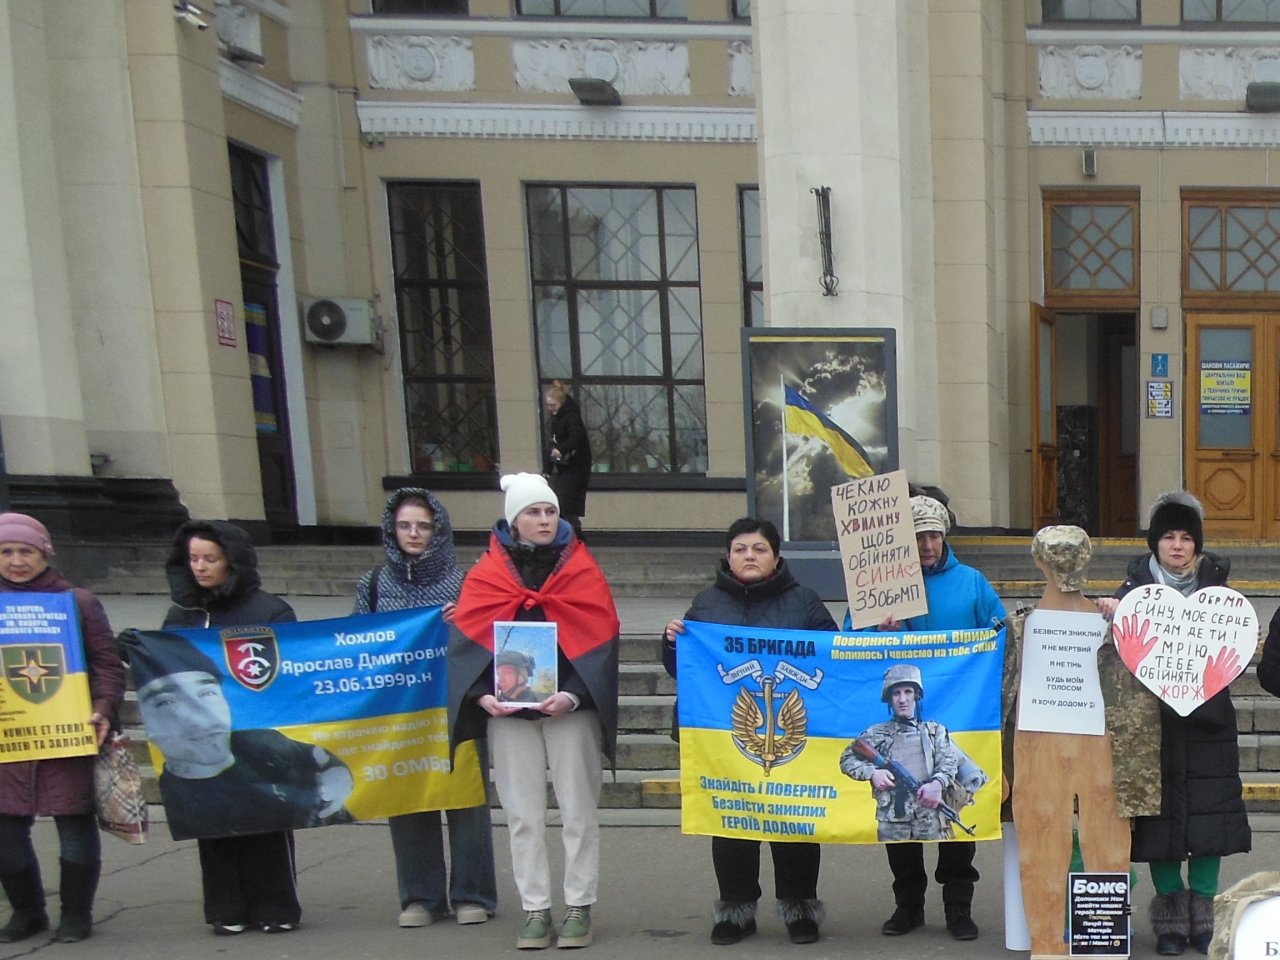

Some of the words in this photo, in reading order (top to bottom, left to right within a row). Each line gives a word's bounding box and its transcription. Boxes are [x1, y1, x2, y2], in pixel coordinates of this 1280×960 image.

[836, 478, 890, 500] ЧЕКАЮ
[848, 496, 898, 517] КОЖНУ
[841, 512, 900, 536] ХВИЛИНУ
[861, 529, 894, 550] ЩОБ
[849, 545, 910, 571] ОБІЙНЯТИ
[855, 563, 904, 588] СИНА
[1142, 588, 1164, 600] 35
[1134, 601, 1175, 620] СИНУ,
[1181, 609, 1207, 622] МОЄ
[1211, 613, 1252, 627] СЕРЦЕ
[334, 630, 396, 646] Хохлов
[832, 634, 900, 648] Повернись
[1033, 628, 1067, 636] БЕЗВІСТИ
[1068, 630, 1102, 638] ЗНИКЛИЙ
[1154, 622, 1180, 636] ТАМ
[1187, 627, 1203, 639] ДЕ
[1209, 629, 1227, 642] ТИ
[724, 636, 744, 653] 35
[748, 638, 816, 659] БРИГАДА
[831, 650, 883, 660] Молимось
[934, 648, 947, 658] на
[1059, 645, 1092, 653] МЕРТВИЙ
[1161, 641, 1208, 658] МРІЮ
[282, 656, 354, 676] Ярослав
[358, 646, 448, 671] Дмитрови
[1155, 656, 1194, 671] ТЕБЕ
[314, 672, 432, 695] 23.06.1999р.н
[1066, 676, 1084, 684] МОЇМ
[1140, 666, 1199, 684] ОБІЙНЯТИ
[1047, 684, 1082, 692] ГОЛОСОМ
[1158, 685, 1204, 700] ЖОРЖ
[1058, 700, 1088, 708] ДОДОМУ
[41, 725, 51, 736] ET
[34, 740, 46, 750] ТА
[363, 764, 388, 782] 30
[700, 776, 756, 794] Знайдіть
[766, 782, 838, 800] ПОВЕРНІТЬ
[712, 796, 766, 814] Безвісти
[768, 804, 827, 818] зниклих
[721, 815, 760, 832] ГЕРОЇВ
[762, 820, 816, 837] ДОДОМУ
[1072, 880, 1128, 894] Боже
